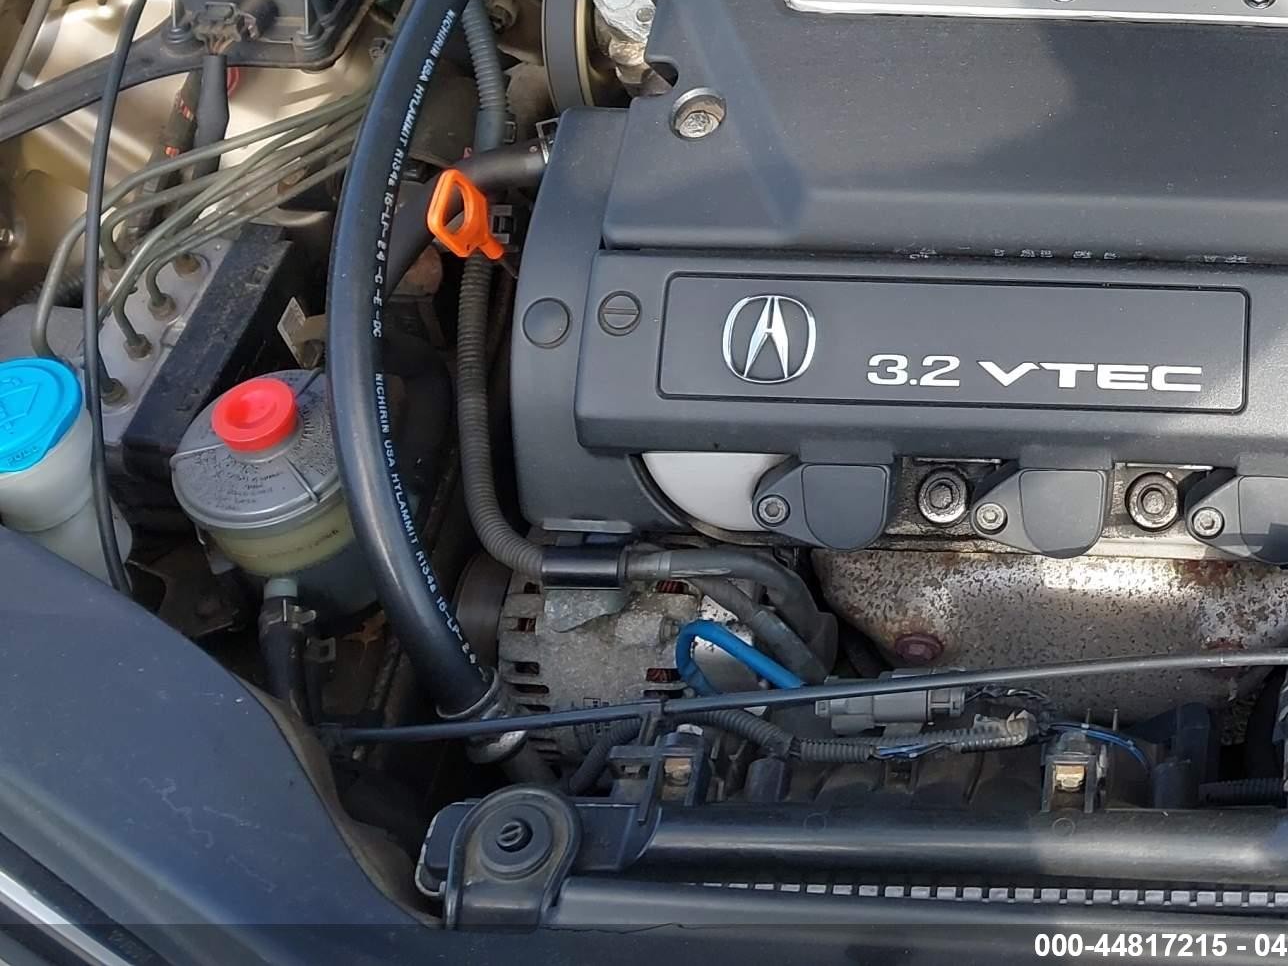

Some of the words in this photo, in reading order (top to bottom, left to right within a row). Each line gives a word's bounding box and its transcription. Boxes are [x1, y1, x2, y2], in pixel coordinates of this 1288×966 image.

[429, 8, 456, 58] NICHIRIN
[418, 58, 435, 83] USA
[867, 354, 961, 387] 3.2
[977, 360, 1202, 392] VTEC
[375, 373, 390, 433] NICHIRIN
[384, 439, 396, 468] USA
[391, 473, 420, 544] HYLAMMIT
